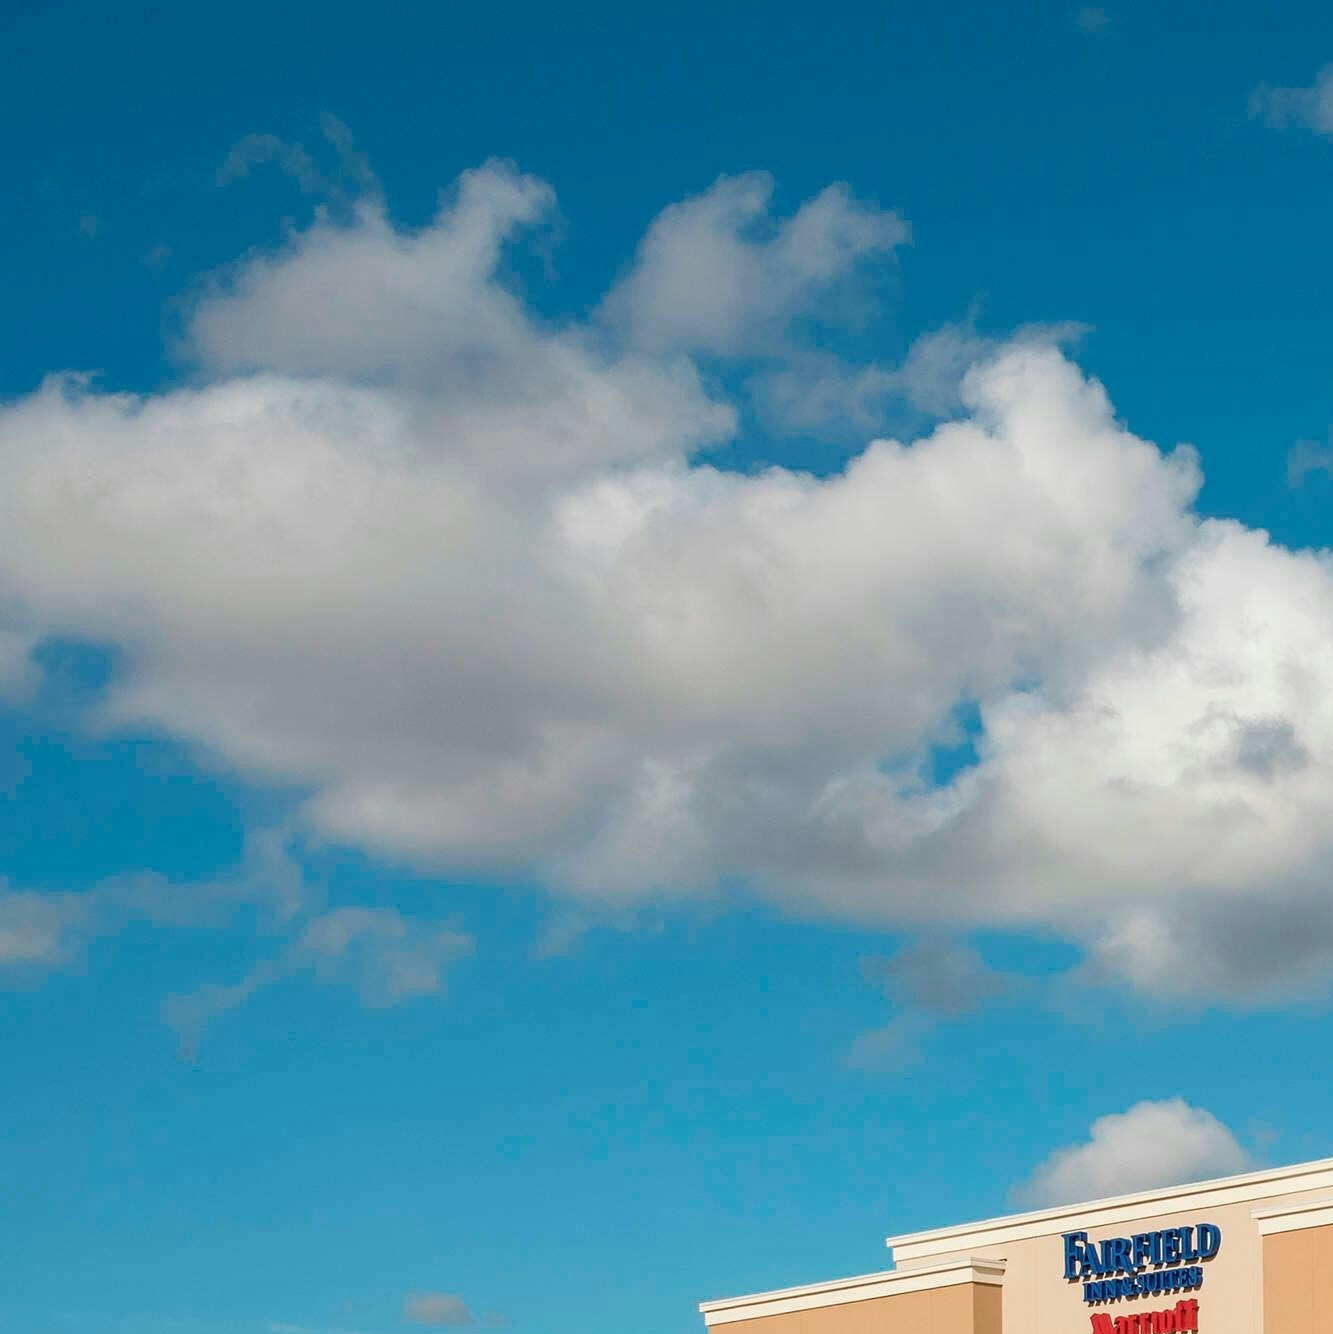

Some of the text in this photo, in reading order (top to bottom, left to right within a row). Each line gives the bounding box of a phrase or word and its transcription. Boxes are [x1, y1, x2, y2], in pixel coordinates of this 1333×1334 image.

[1061, 1223, 1222, 1279] FAIRFIELD
[1083, 1266, 1203, 1302] INN & SUITES
